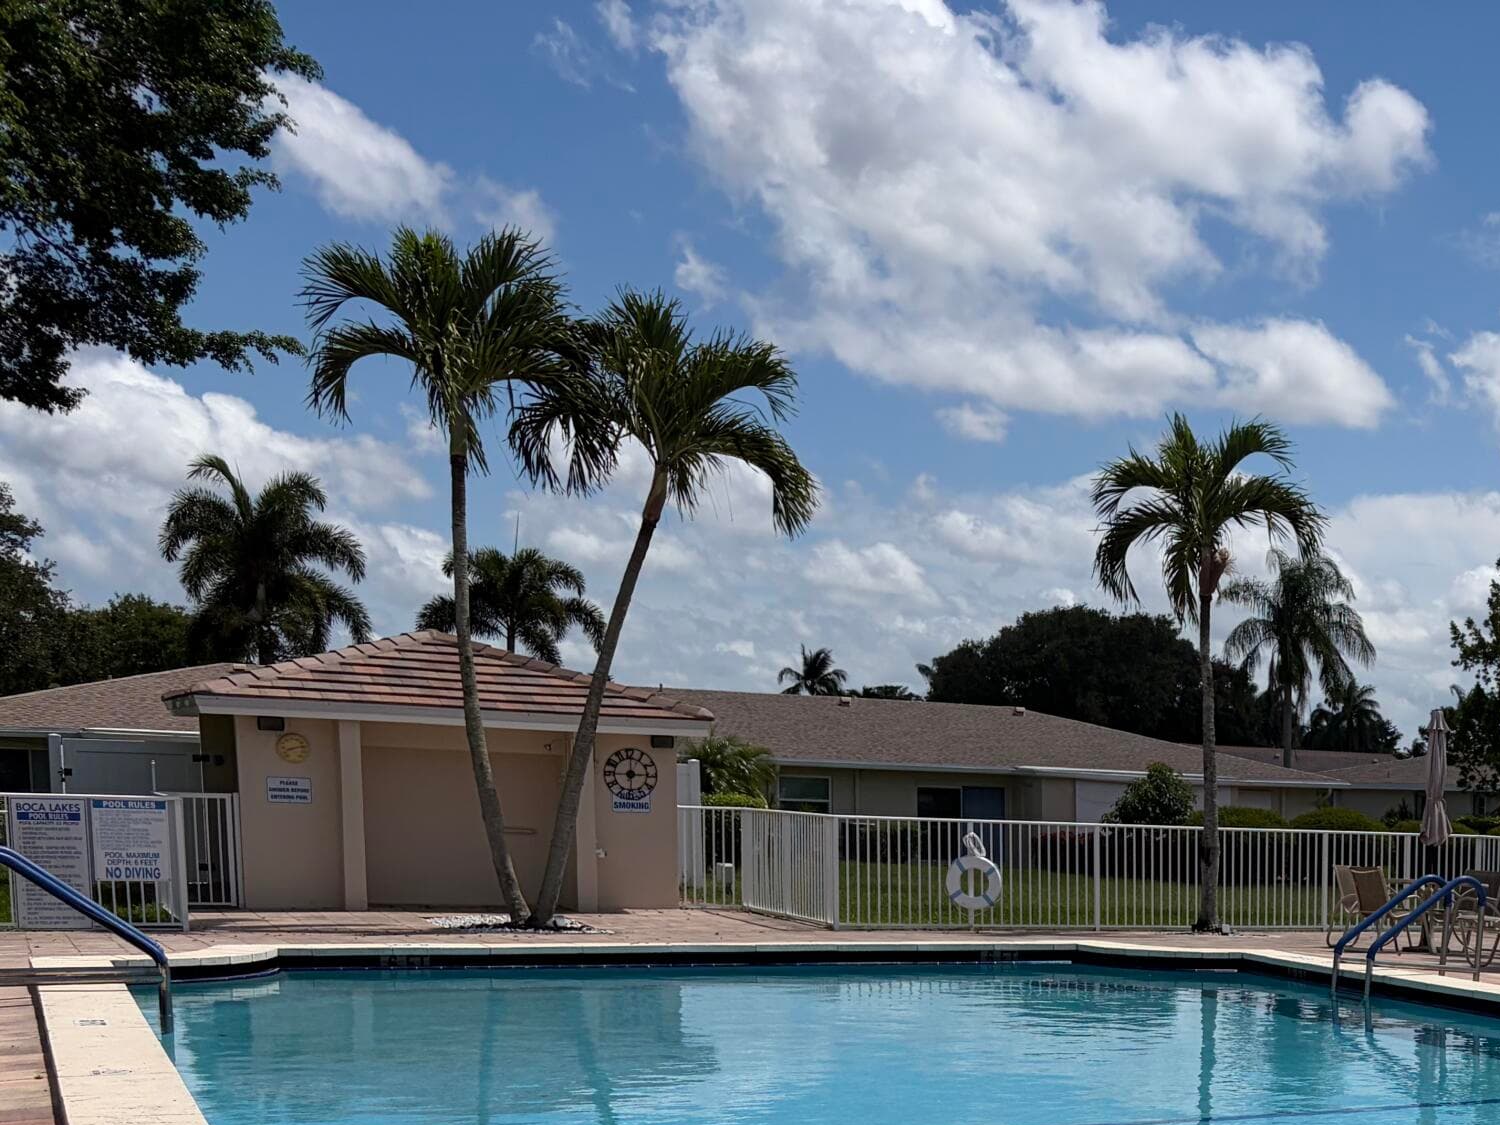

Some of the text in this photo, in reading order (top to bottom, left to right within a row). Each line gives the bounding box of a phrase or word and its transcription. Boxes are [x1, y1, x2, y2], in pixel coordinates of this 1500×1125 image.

[16, 802, 80, 813] BOCA LAKES
[102, 800, 156, 810] POOL RULES
[614, 801, 650, 810] SMOKING
[28, 812, 69, 821] POOL RULES
[104, 851, 124, 859] POOL
[105, 866, 161, 880] NO DIVING
